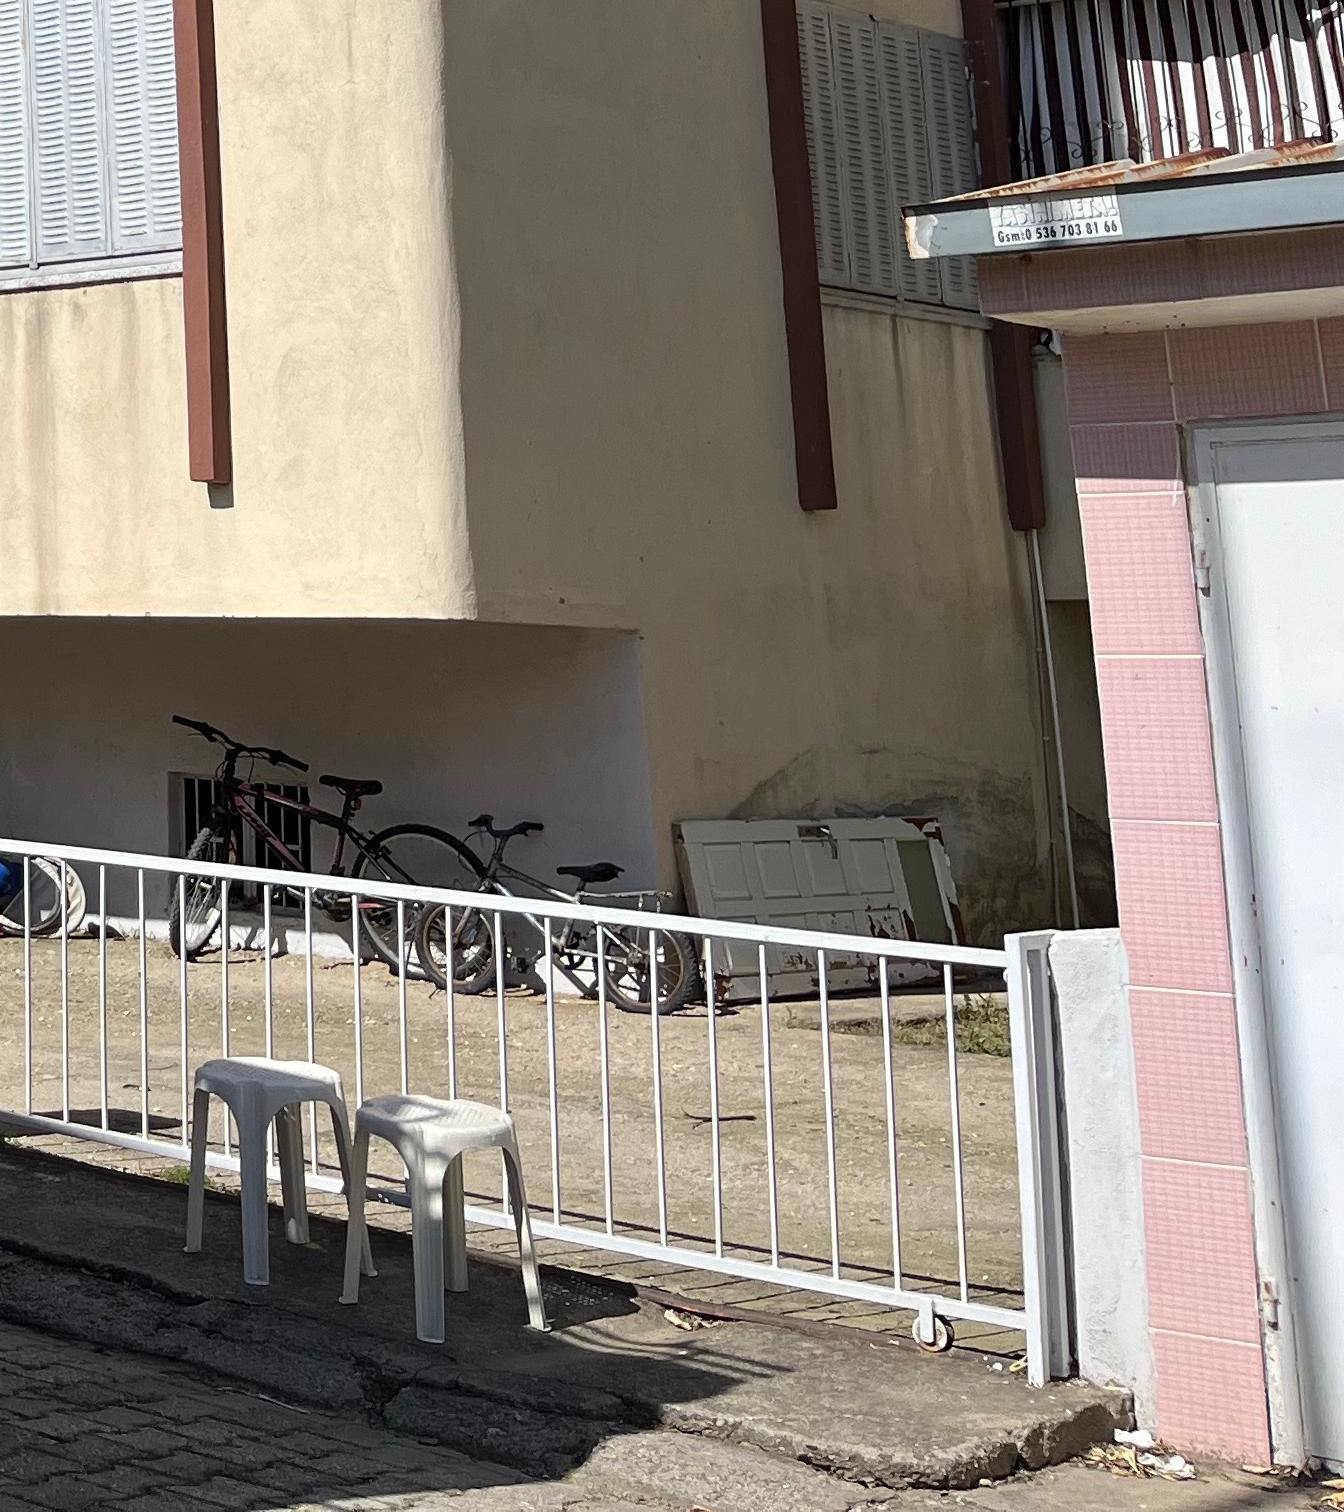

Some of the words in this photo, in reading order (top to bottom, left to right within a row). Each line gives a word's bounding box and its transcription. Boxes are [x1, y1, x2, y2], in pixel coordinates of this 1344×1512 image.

[1035, 225, 1057, 240] 536
[1060, 223, 1082, 238] 703
[1086, 221, 1099, 236] 81
[1103, 219, 1118, 234] 66
